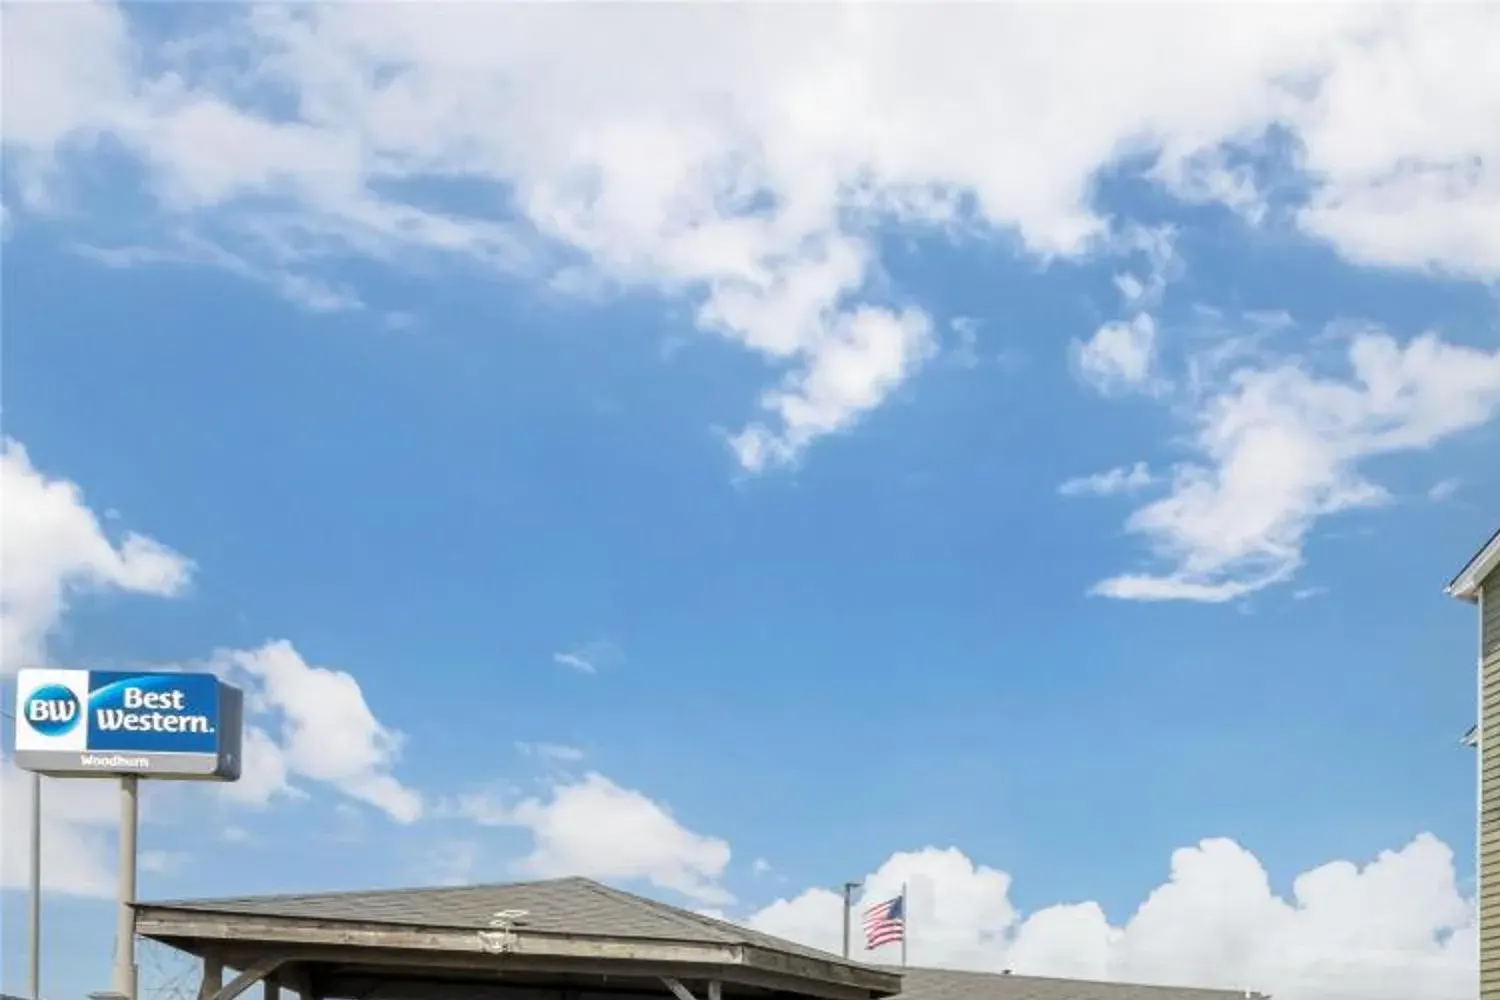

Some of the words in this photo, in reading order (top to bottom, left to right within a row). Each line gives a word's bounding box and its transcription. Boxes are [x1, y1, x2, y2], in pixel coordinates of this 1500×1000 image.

[123, 687, 185, 710] Best
[29, 699, 75, 722] BW
[80, 754, 149, 768] Woodburn
